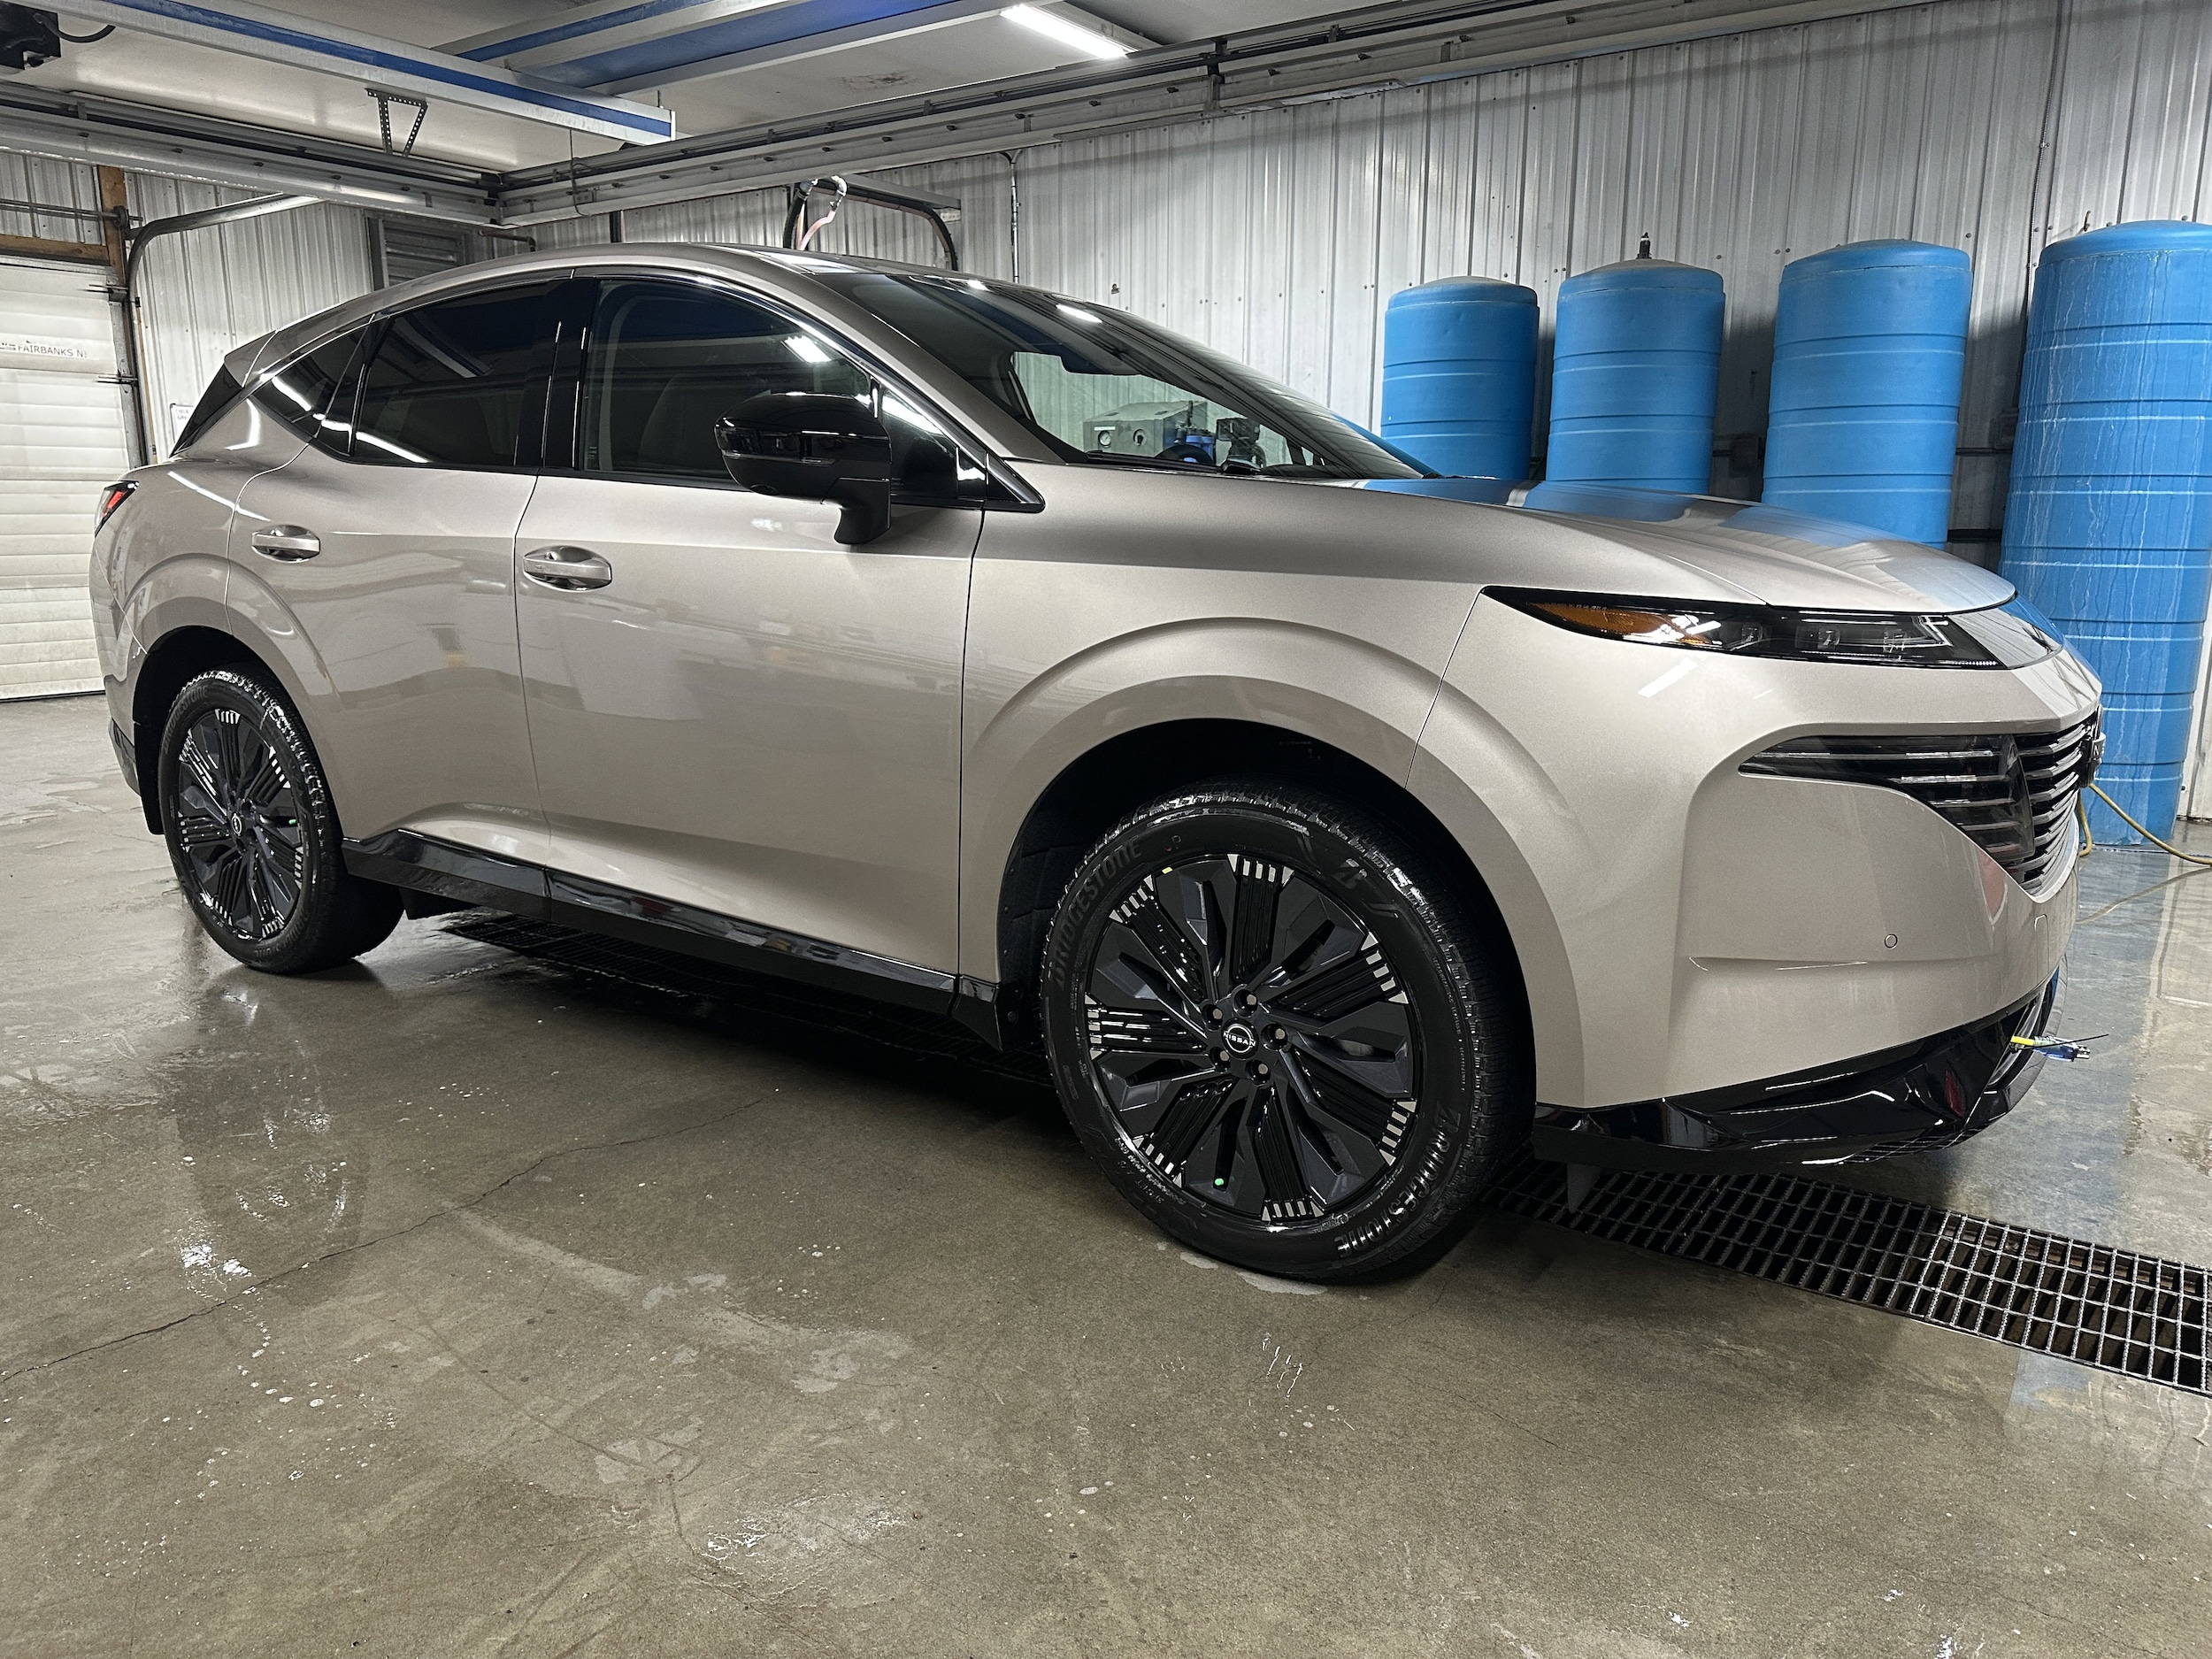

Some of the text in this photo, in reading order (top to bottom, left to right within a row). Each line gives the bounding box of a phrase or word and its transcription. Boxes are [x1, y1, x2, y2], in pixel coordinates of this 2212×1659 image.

[18, 344, 73, 357] FAIRBANKS
[1047, 834, 1142, 987] BRIDGESTONE
[1223, 1030, 1256, 1048] NISSAN
[1333, 1099, 1461, 1259] BRIDGESTONE
